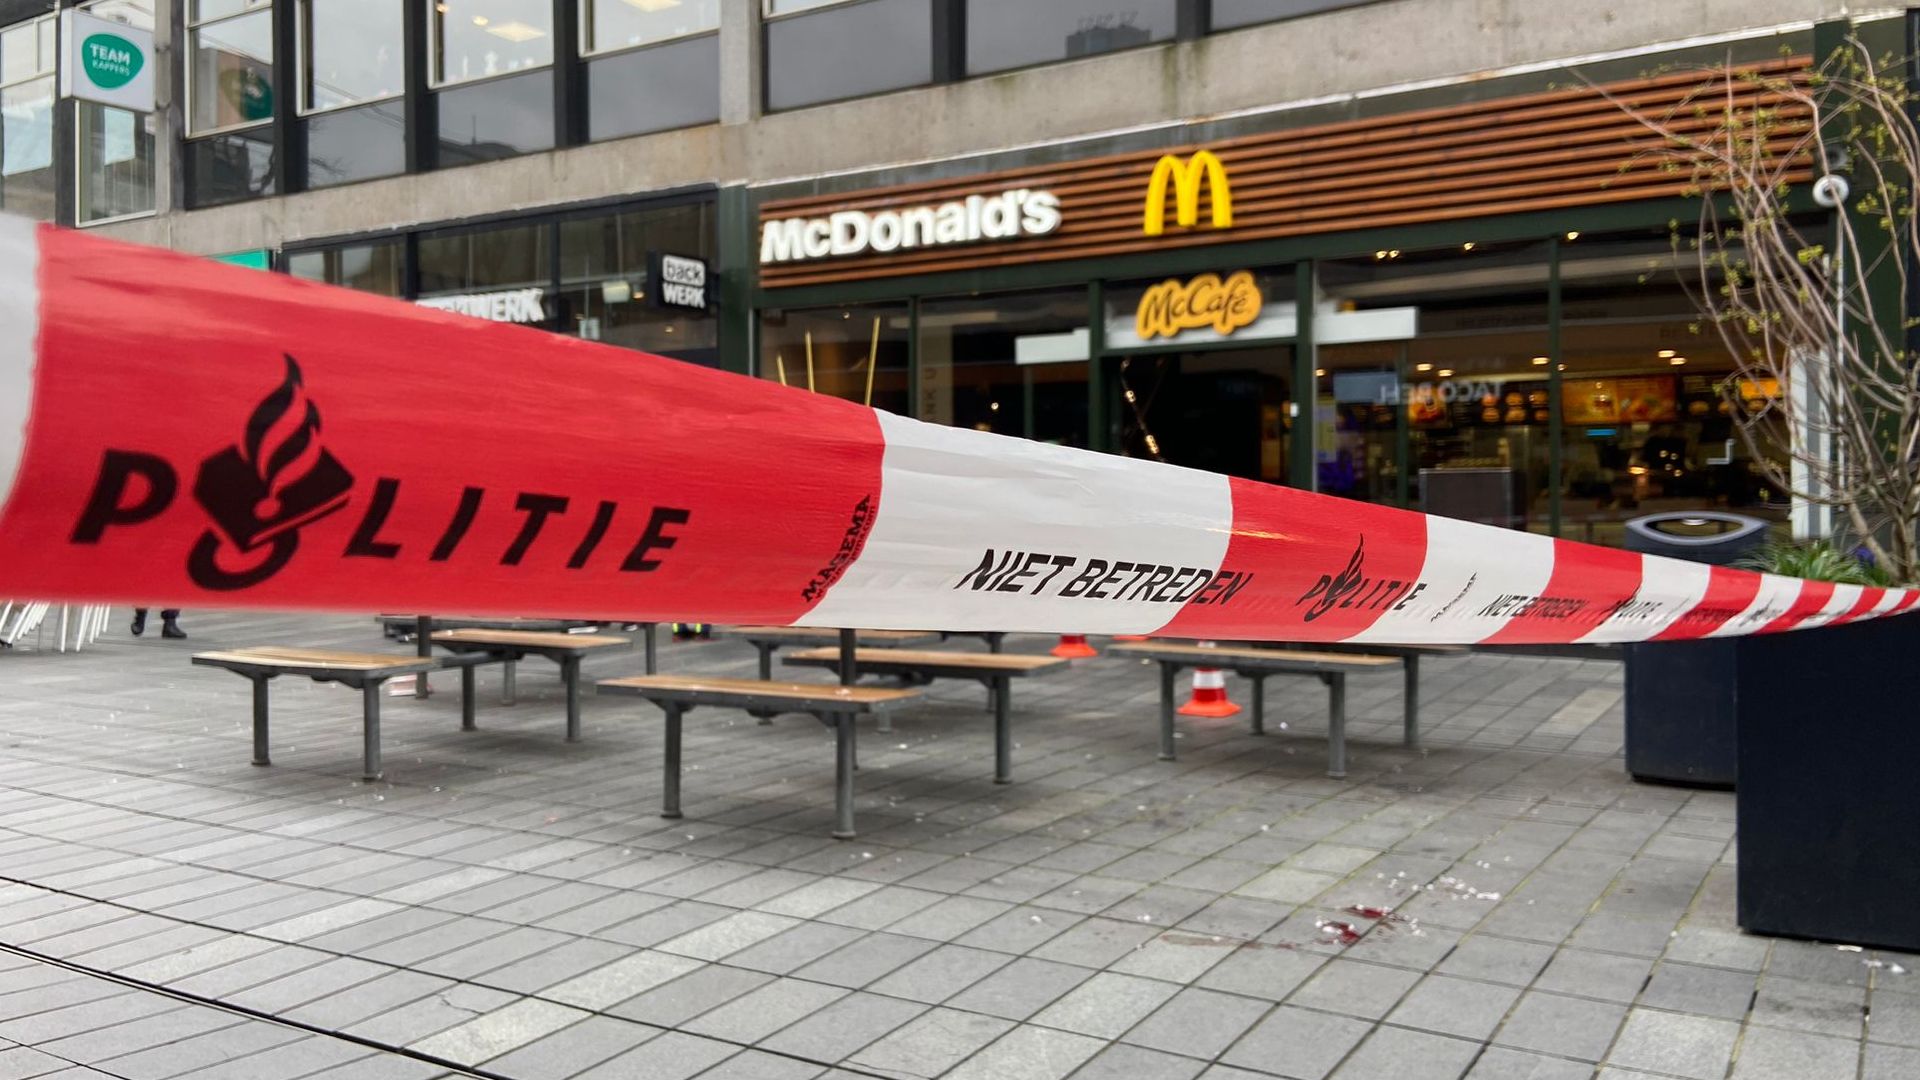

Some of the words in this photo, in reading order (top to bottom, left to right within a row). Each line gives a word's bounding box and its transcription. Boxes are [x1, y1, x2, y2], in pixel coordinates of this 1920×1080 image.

[90, 44, 130, 64] TEAM
[92, 59, 130, 76] KAPPERS
[760, 189, 1060, 263] McDonald's
[667, 260, 701, 281] back
[663, 282, 705, 308] WERK
[1140, 275, 1252, 333] McCafé
[953, 549, 1077, 595] NIET
[1057, 558, 1254, 605] BETREDEN
